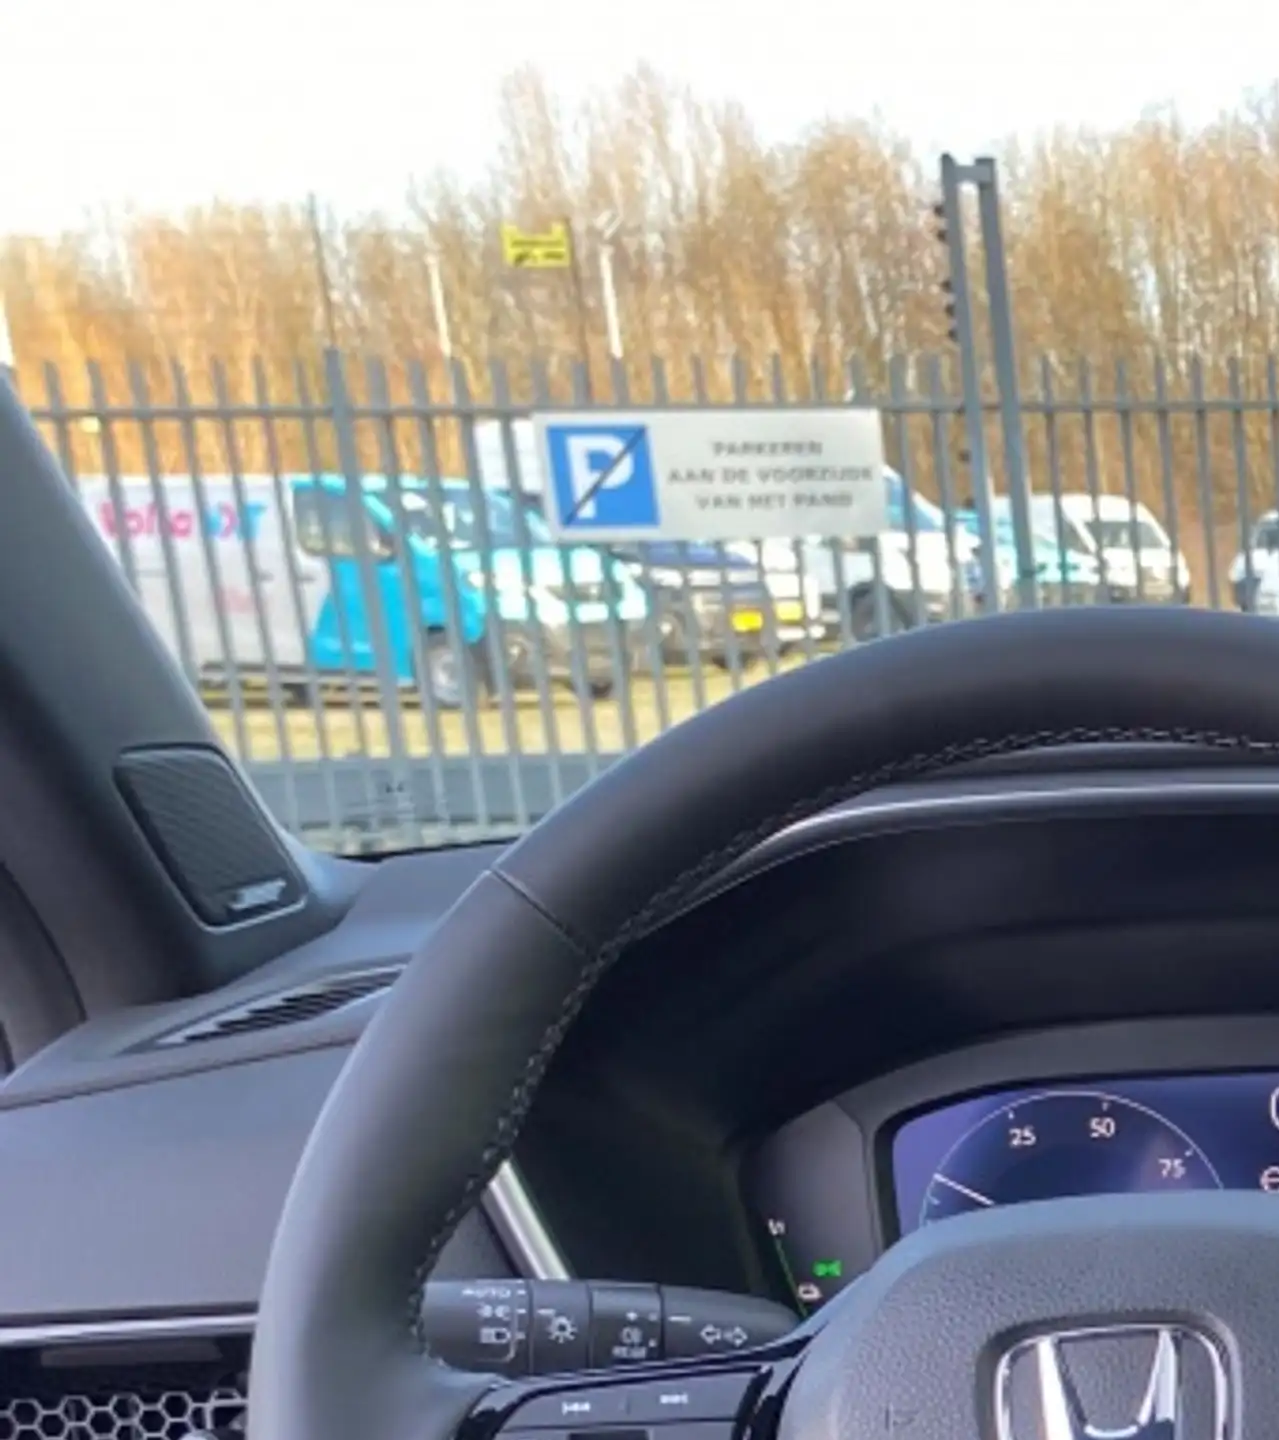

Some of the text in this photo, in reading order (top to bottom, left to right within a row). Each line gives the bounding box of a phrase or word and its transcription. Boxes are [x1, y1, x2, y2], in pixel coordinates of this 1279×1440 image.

[712, 440, 824, 457] PARKEREN
[668, 465, 874, 485] AAN DE VOORZIJDE
[695, 491, 854, 511] VAN HET PAND
[1008, 1124, 1037, 1148] 25
[1088, 1115, 1117, 1139] 50
[1157, 1157, 1187, 1180] 75
